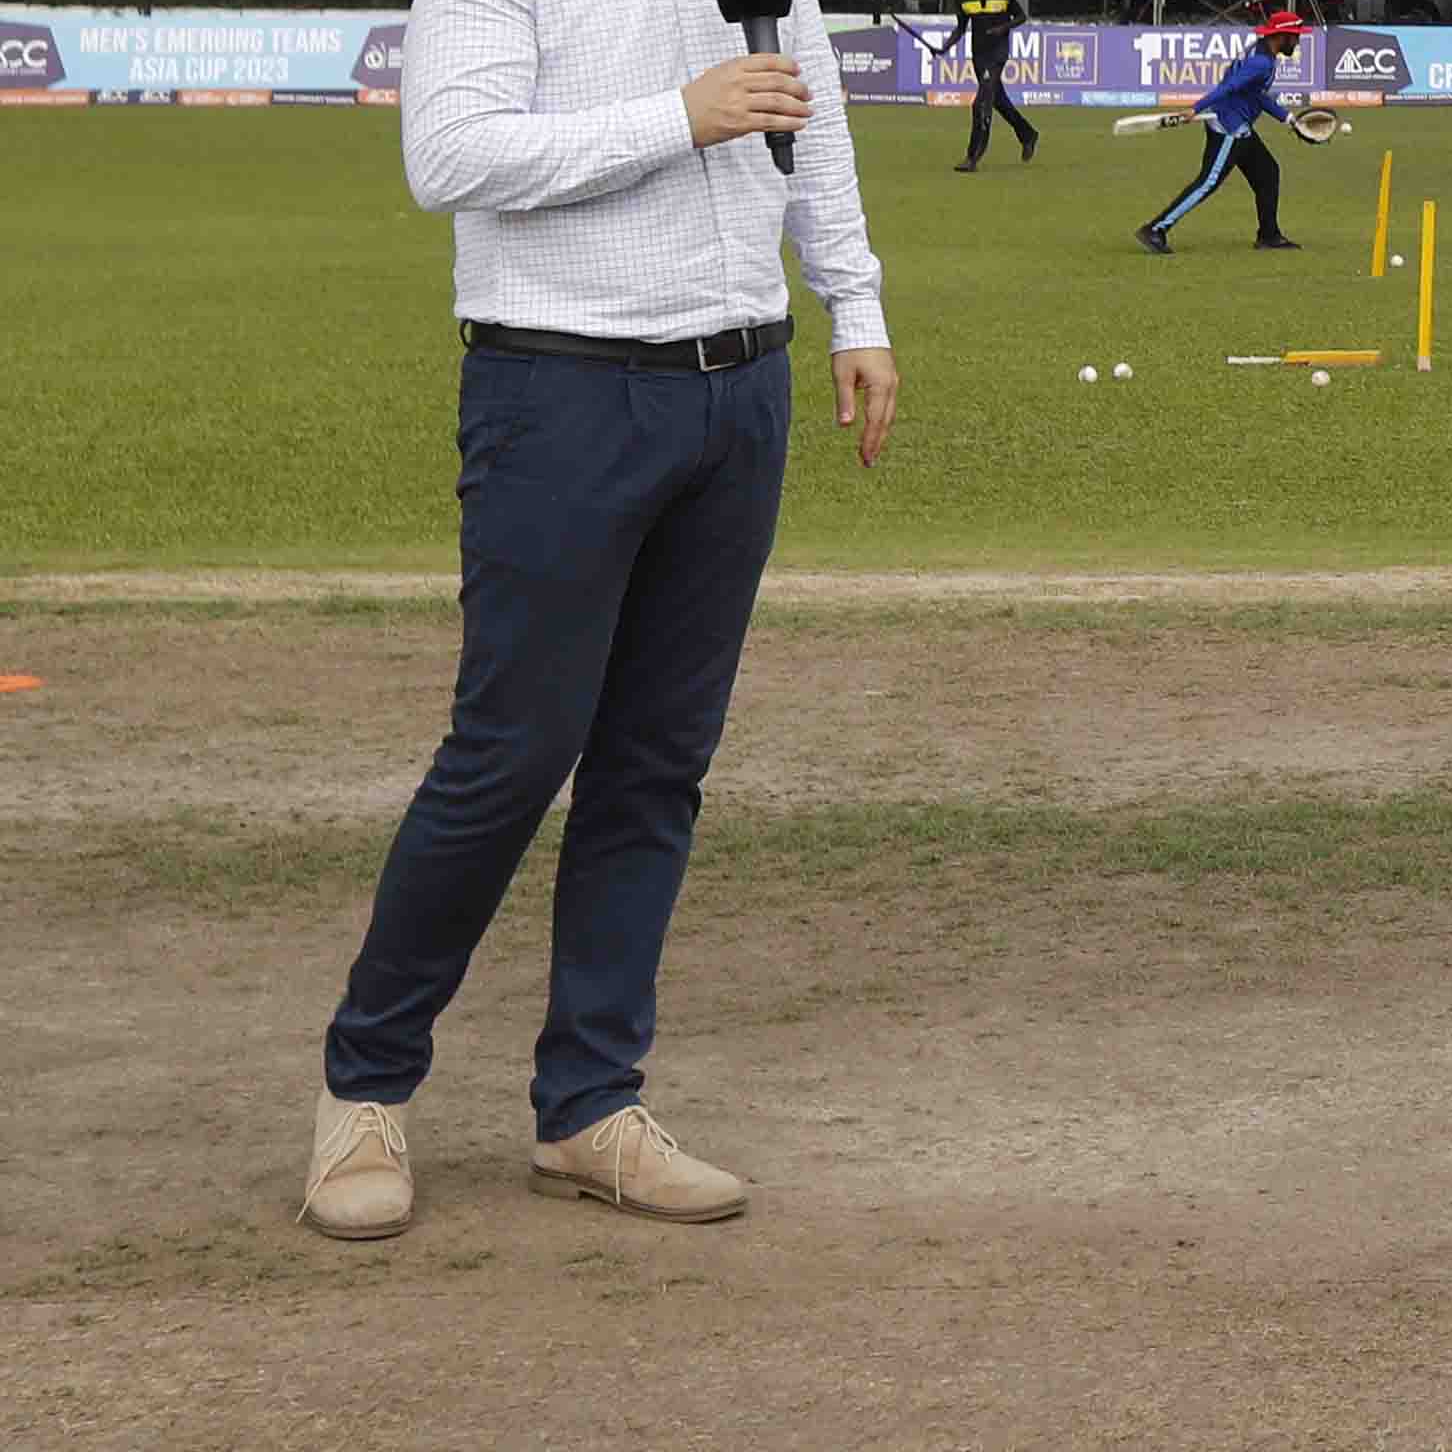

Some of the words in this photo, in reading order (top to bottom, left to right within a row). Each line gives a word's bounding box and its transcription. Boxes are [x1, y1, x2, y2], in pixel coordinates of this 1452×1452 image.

[79, 27, 148, 53] MEN'S
[154, 27, 264, 53] EMERGING
[271, 27, 343, 53] TEAMS
[130, 56, 178, 84] ASIA
[186, 56, 228, 84] CUP
[233, 56, 289, 84] 2023
[1335, 48, 1396, 74] ACC
